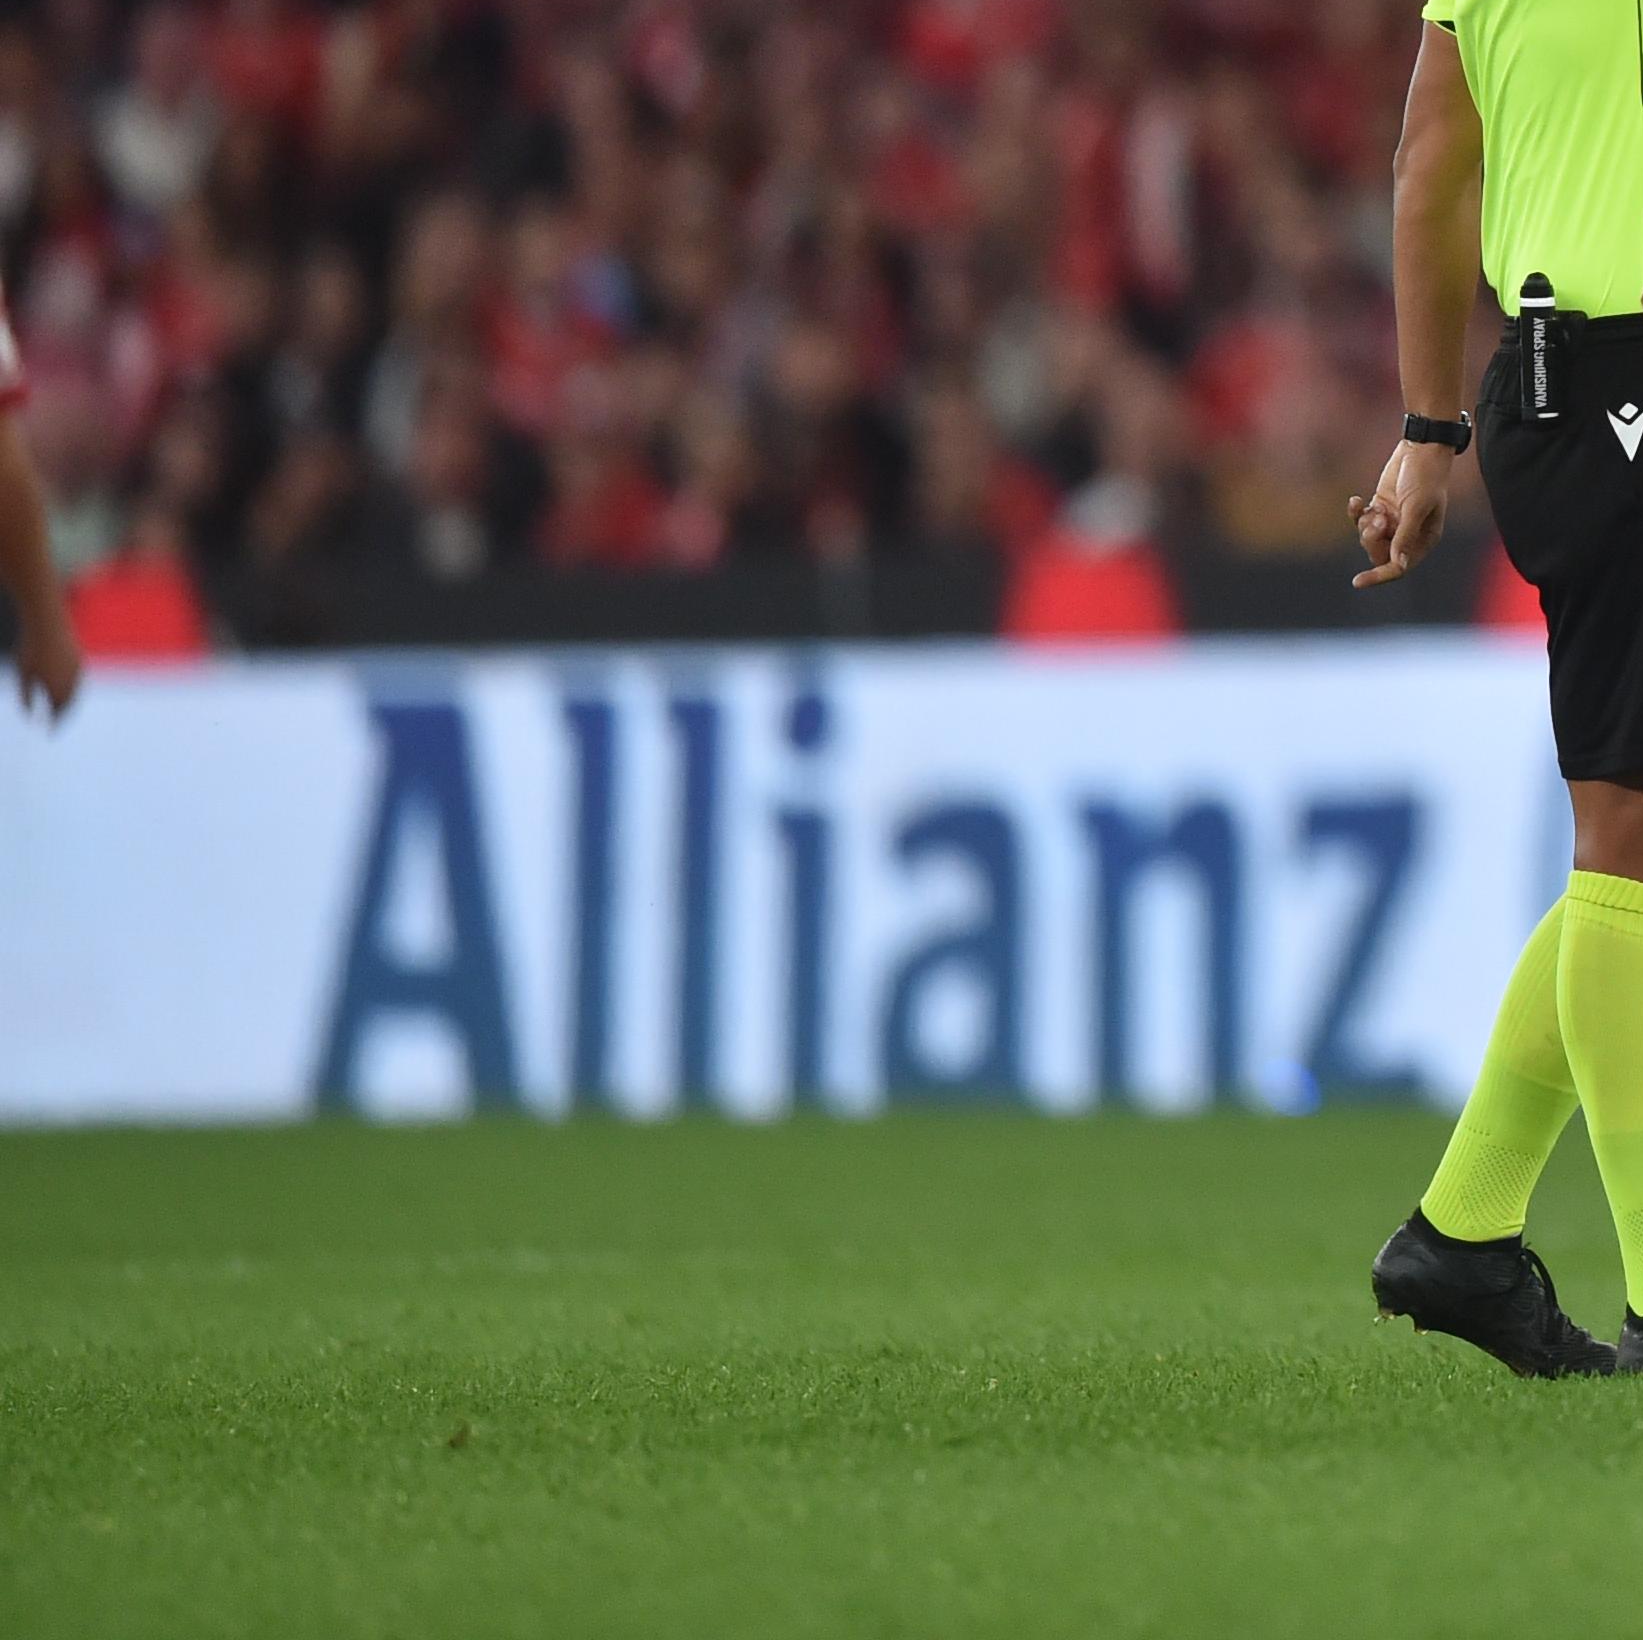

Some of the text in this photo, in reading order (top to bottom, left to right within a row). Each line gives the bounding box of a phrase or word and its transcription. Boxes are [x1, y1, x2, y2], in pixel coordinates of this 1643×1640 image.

[1533, 317, 1548, 408] VANISHING SPRAY
[315, 665, 1430, 1110] Allianz
